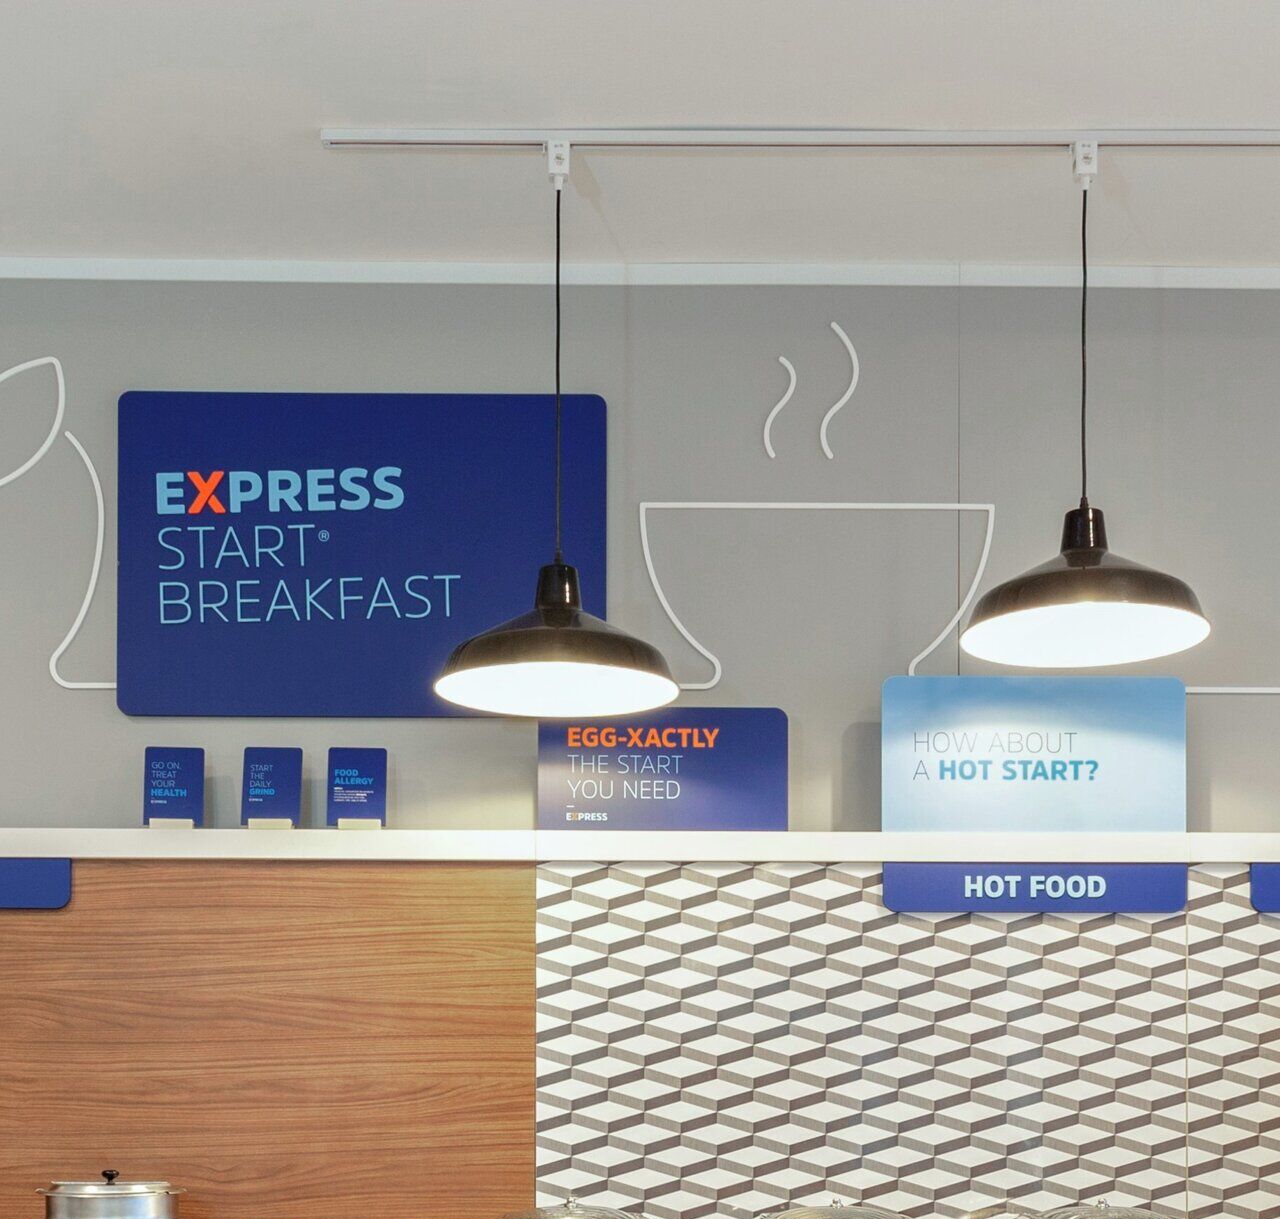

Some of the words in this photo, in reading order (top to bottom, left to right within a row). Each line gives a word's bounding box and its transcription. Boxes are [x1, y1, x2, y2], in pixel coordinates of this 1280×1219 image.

[156, 466, 405, 515] EXPRESS
[159, 575, 461, 625] BREAKFAST
[567, 727, 719, 748] EGG-XACTLY
[913, 732, 978, 753] HOW
[988, 732, 1078, 753] ABOUT
[152, 761, 164, 769] GO
[567, 754, 609, 774] THE
[617, 754, 684, 775] START
[913, 760, 930, 781] A
[938, 759, 993, 781] HOT
[1002, 759, 1099, 781] START?
[152, 770, 177, 778] TREAT
[334, 777, 374, 785] ALLERGY
[151, 780, 175, 788] YOUR
[249, 780, 272, 788] DAILY
[567, 779, 614, 799] YOU
[623, 780, 681, 800] NEED
[150, 788, 187, 797] HEALTH
[249, 788, 275, 796] GRIND
[566, 812, 608, 821] EXPRESS
[963, 874, 1021, 899] HOT
[1029, 875, 1107, 900] FOOD
